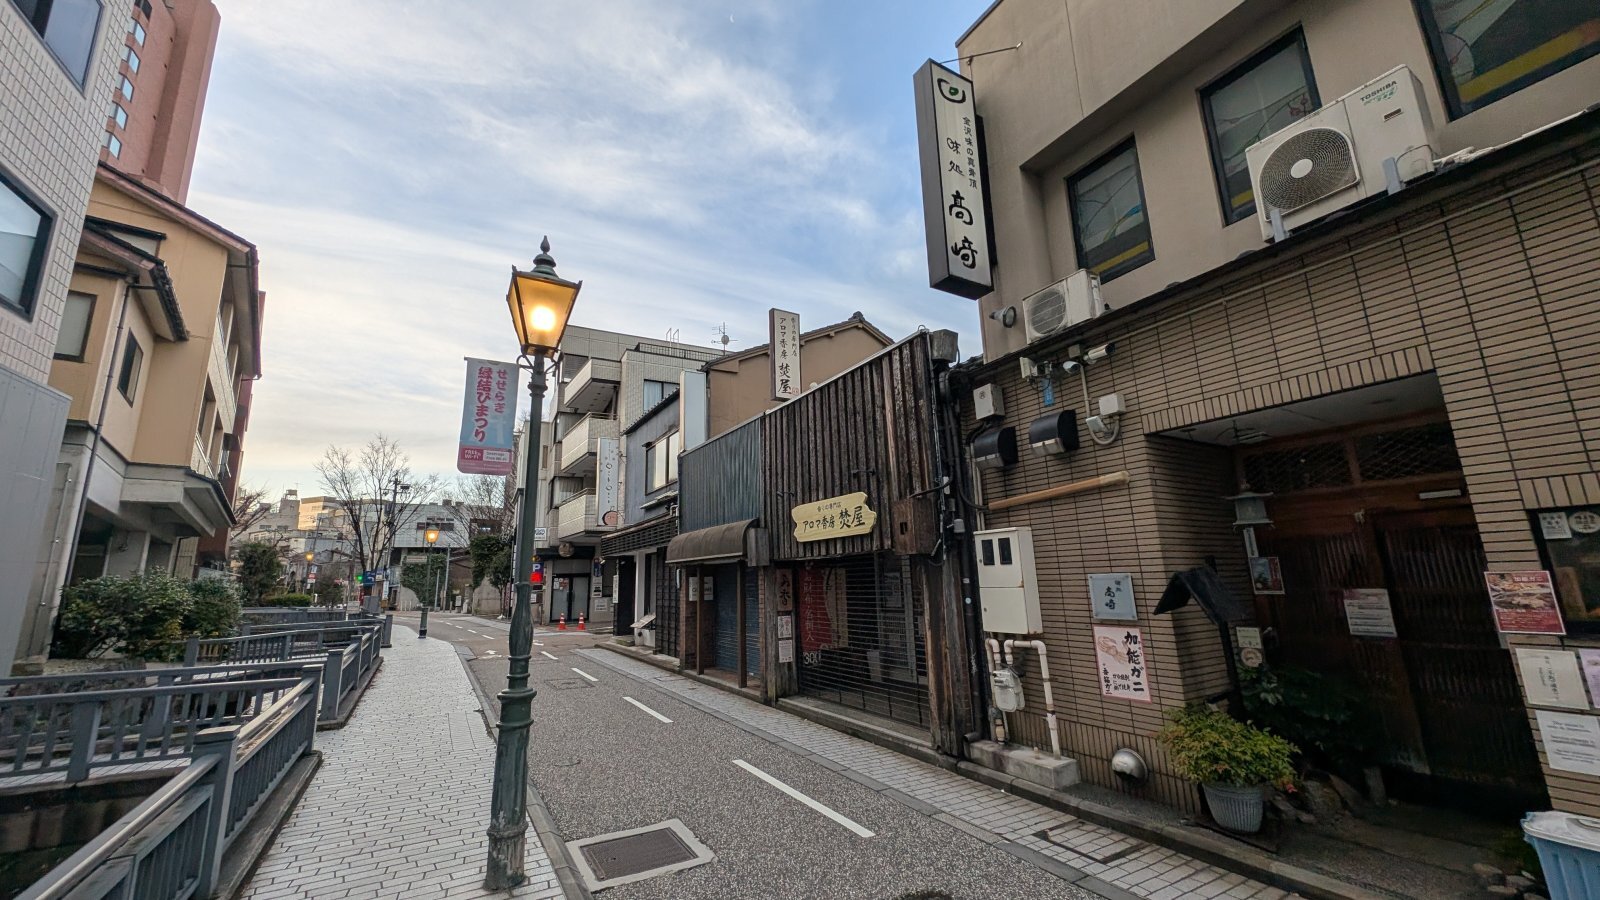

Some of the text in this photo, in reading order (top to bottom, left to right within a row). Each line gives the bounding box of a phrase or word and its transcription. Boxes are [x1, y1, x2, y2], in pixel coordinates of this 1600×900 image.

[1361, 80, 1397, 102] TOSHIBA
[946, 137, 965, 177] 味処
[494, 369, 508, 414] せせらぎ
[778, 362, 793, 395] 焚屋
[474, 366, 493, 443] 縁結びまつり
[803, 505, 866, 533] アロマ香房 焚屋
[532, 563, 541, 572] P
[1124, 630, 1145, 692] 加能ガニ
